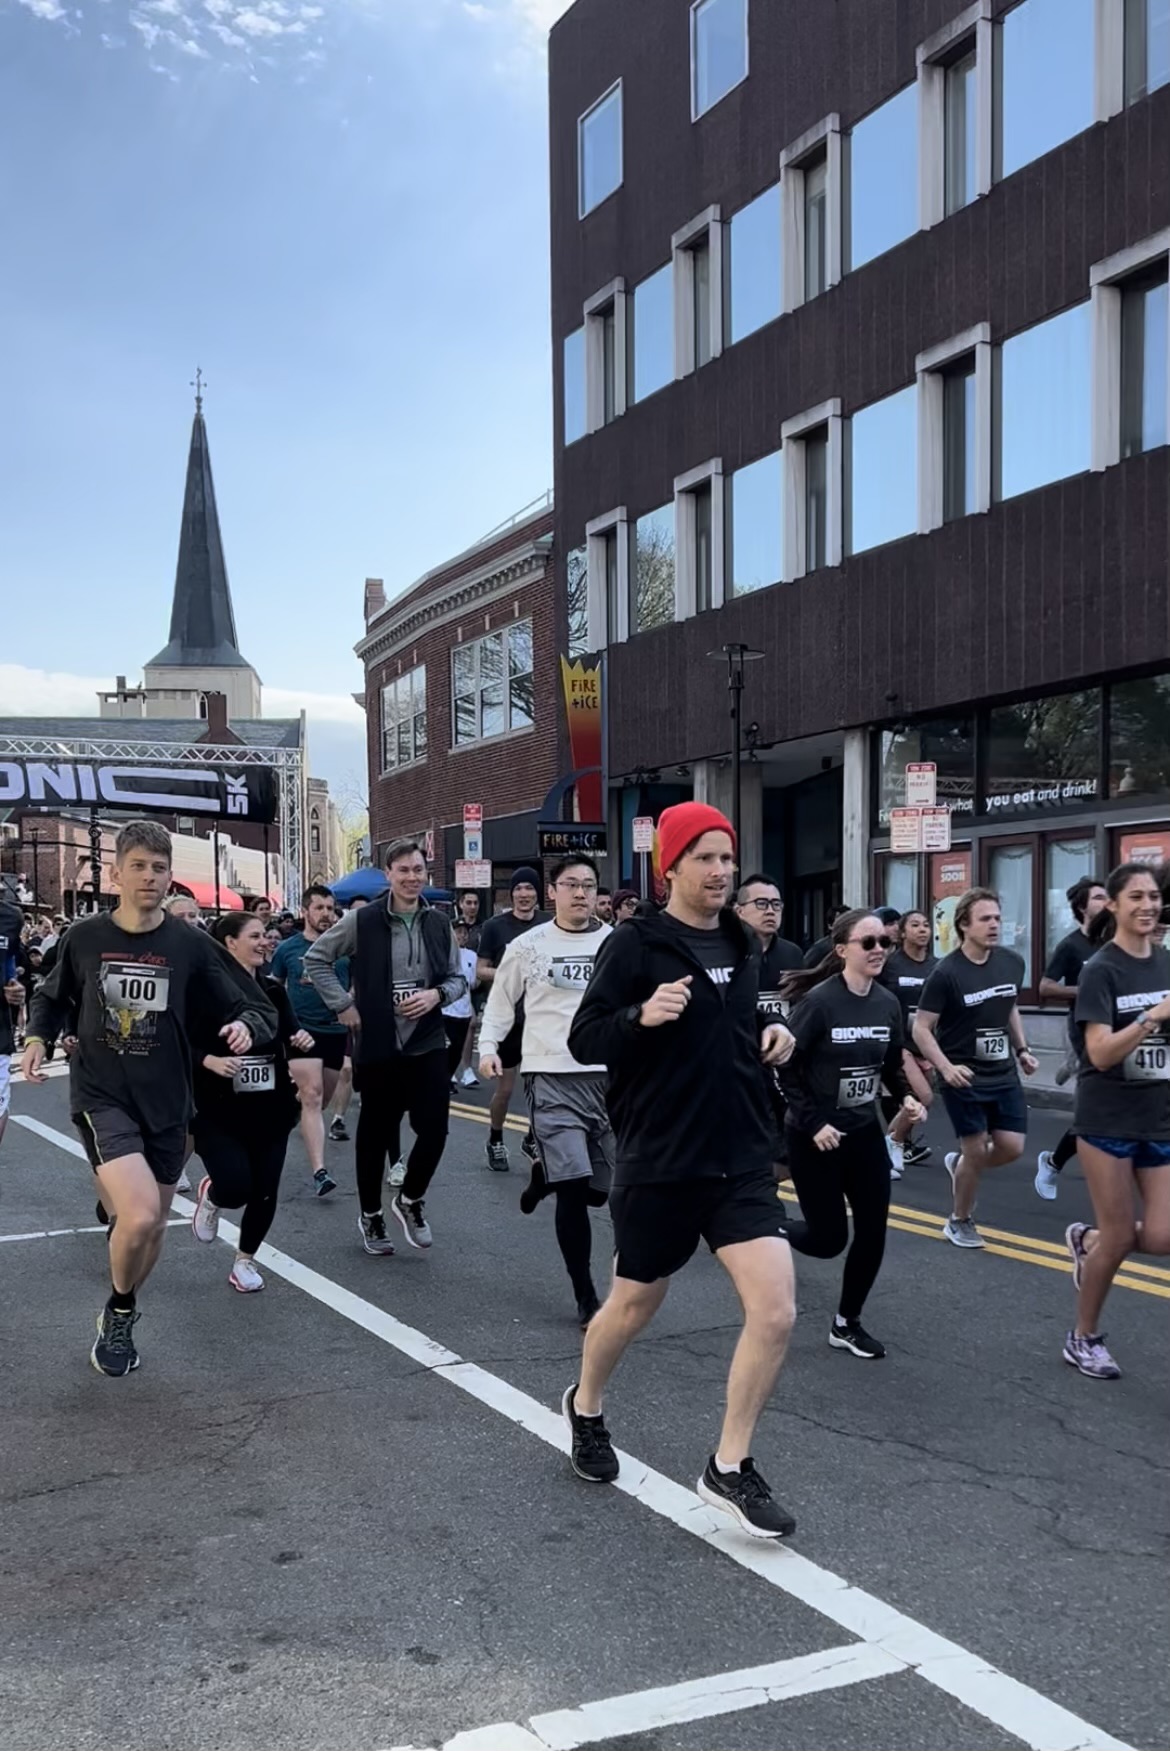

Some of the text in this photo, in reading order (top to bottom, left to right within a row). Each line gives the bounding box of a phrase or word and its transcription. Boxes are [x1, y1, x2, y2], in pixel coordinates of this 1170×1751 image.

[224, 773, 248, 815] 5K
[985, 794, 1010, 812] you
[1013, 789, 1036, 804] eat
[1037, 783, 1060, 800] and
[1062, 778, 1098, 798] drink!
[562, 964, 592, 981] 428
[118, 978, 156, 1001] 100
[831, 1026, 890, 1040] BIONIC
[984, 1038, 1004, 1054] 129
[1135, 1048, 1166, 1069] 410
[240, 1066, 269, 1083] 308
[847, 1078, 874, 1098] 394
